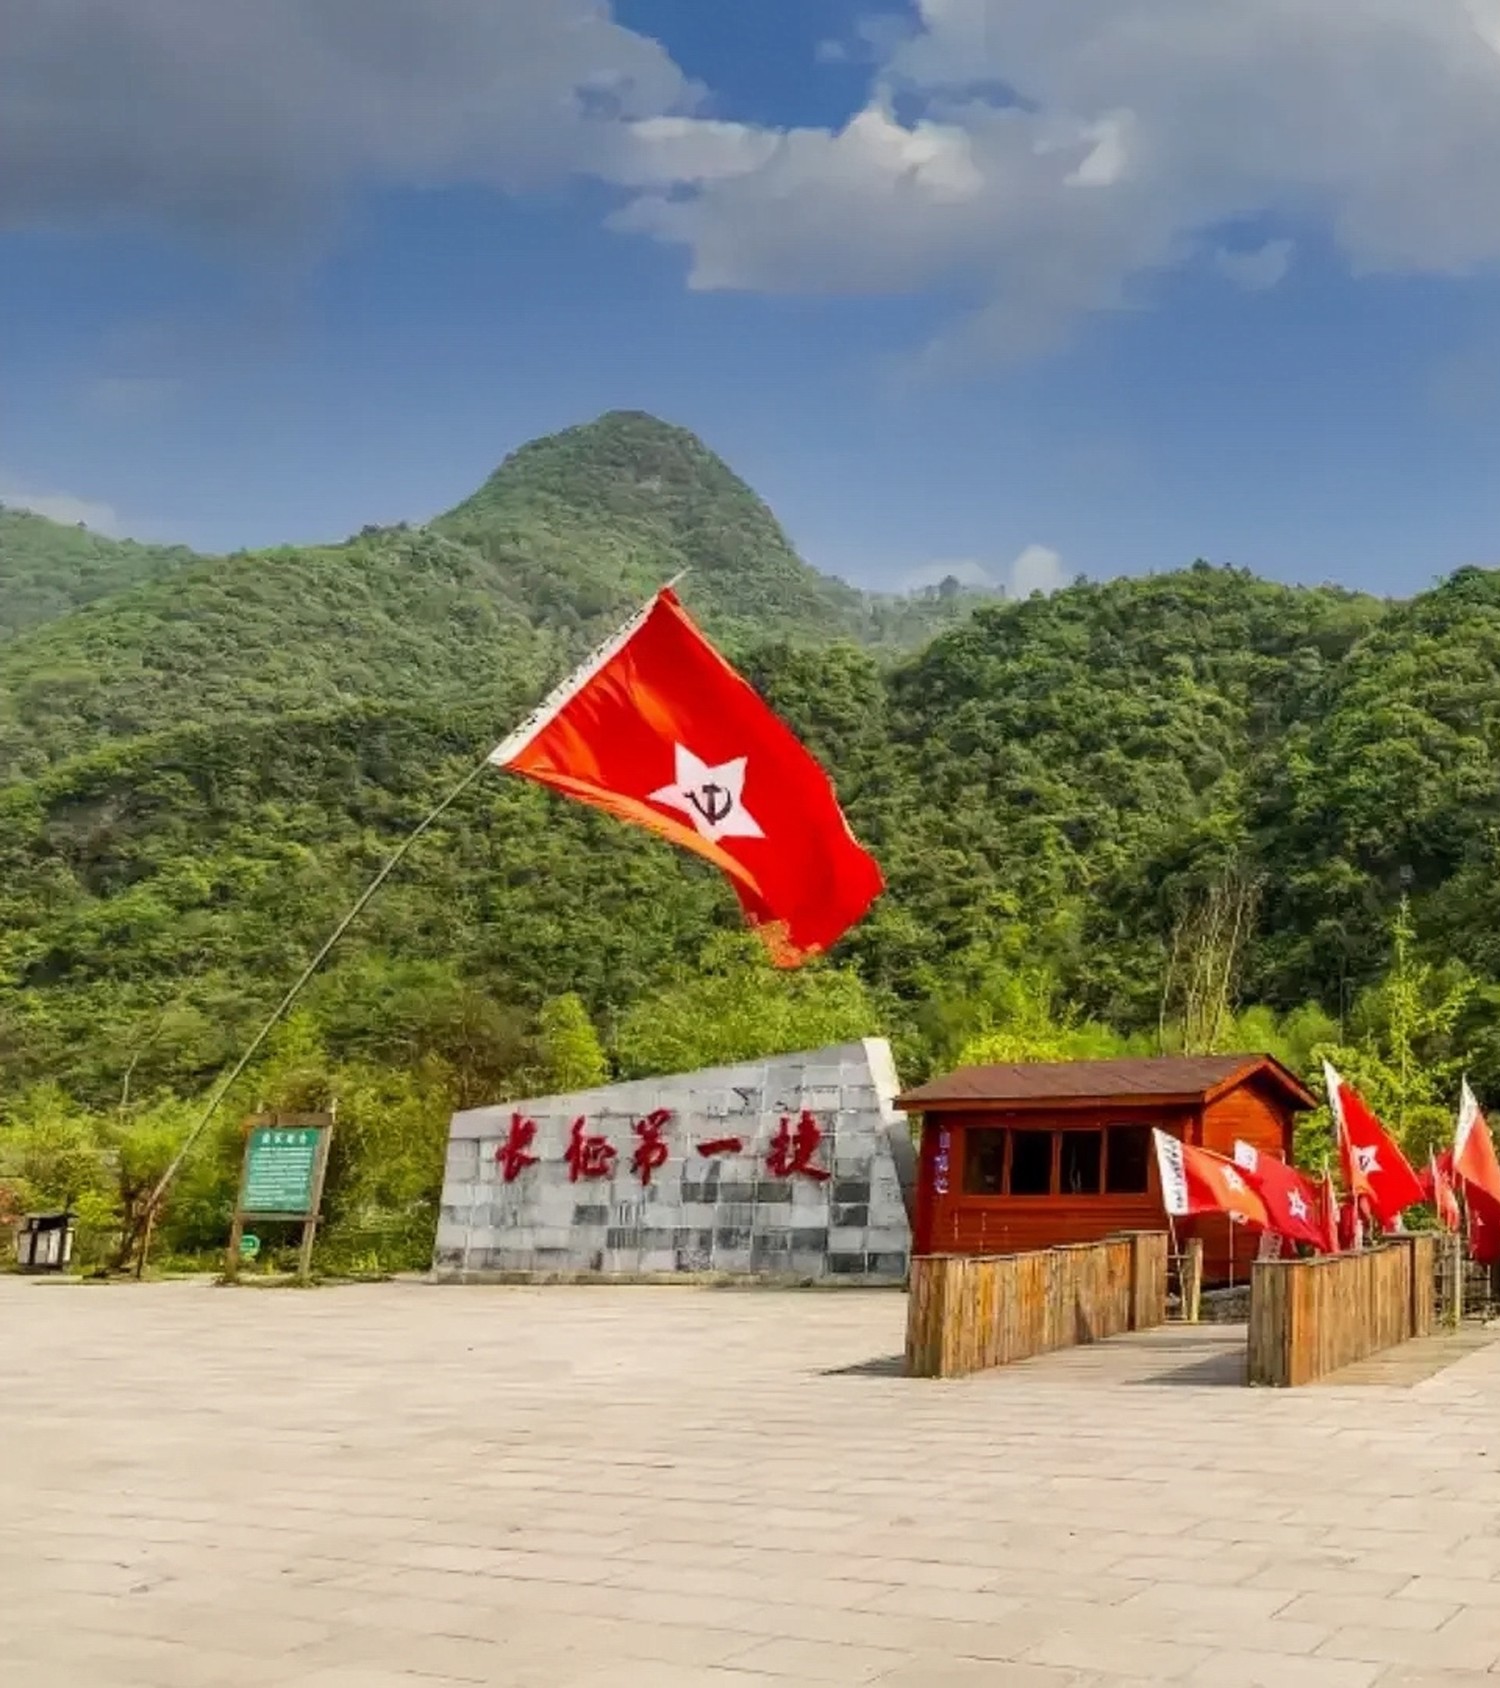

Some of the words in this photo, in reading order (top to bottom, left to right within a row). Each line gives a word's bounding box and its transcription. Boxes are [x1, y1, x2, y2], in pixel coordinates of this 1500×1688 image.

[495, 1108, 832, 1187] 长征第一捷
